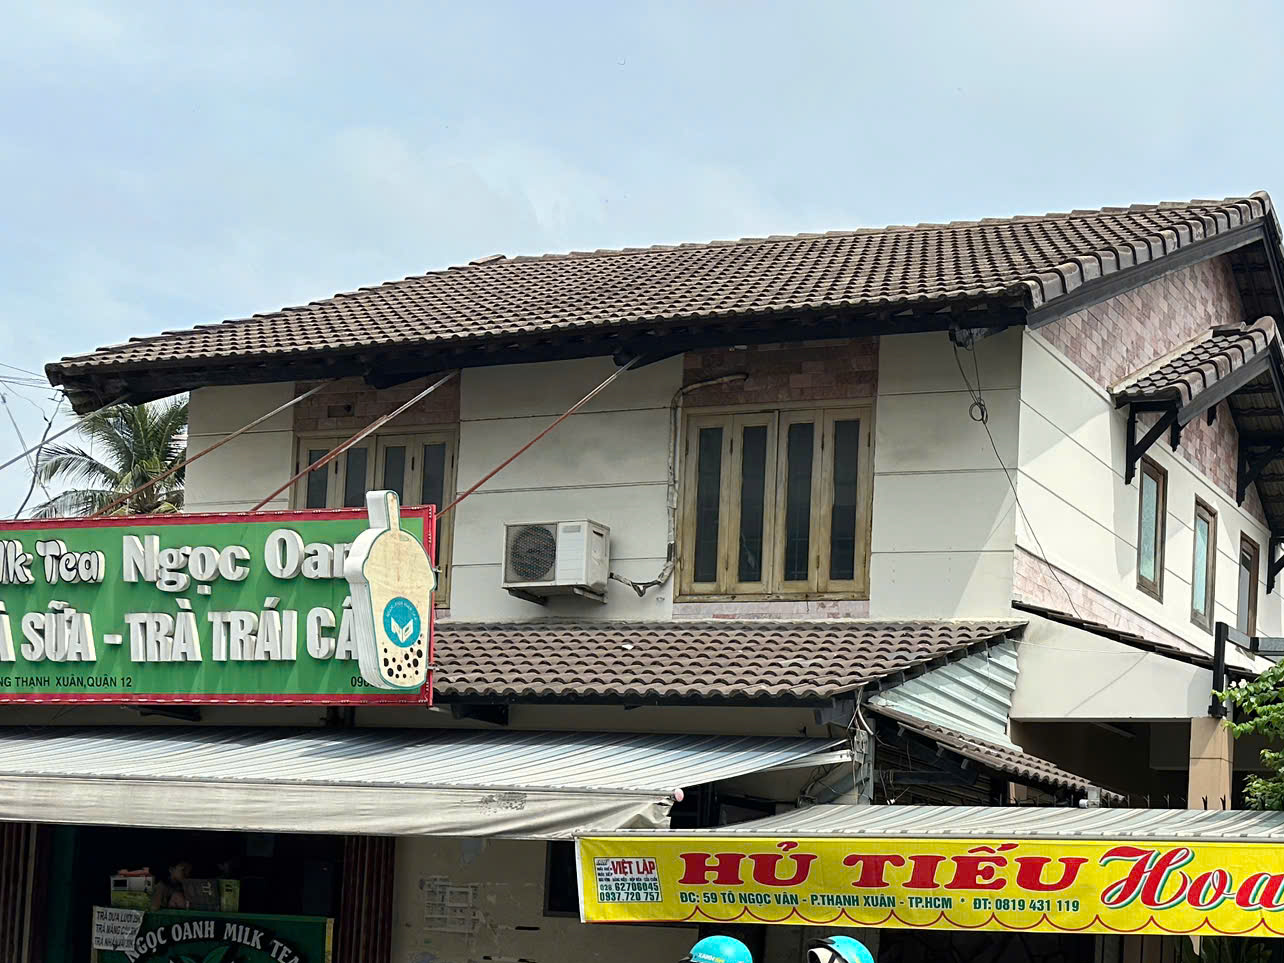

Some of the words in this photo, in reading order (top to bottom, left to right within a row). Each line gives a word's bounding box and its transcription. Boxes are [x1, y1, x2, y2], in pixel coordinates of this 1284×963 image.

[35, 539, 105, 585] Tea
[123, 535, 250, 596] Ngọc
[21, 600, 97, 662] SỮA
[124, 598, 203, 663] TRÀ
[207, 595, 298, 662] TRÁI
[15, 676, 50, 690] THẠNH
[120, 677, 132, 688] 12
[611, 859, 633, 876] VIỆT
[677, 841, 818, 888] HỦ
[842, 842, 1090, 893] TIẾU
[643, 892, 660, 902] 757
[680, 891, 700, 903] ĐC:
[703, 892, 718, 904] 59
[738, 892, 772, 907] NGỌC
[774, 892, 799, 905] VÂN
[810, 894, 860, 908] P.THẠNH
[863, 894, 896, 908] XUÂN
[907, 896, 953, 909] TP.HCM
[973, 898, 992, 910] ĐT:
[995, 898, 1026, 911] 0819
[1029, 899, 1051, 912] 431
[1057, 900, 1080, 912] 119
[124, 926, 167, 963] NGỌC
[171, 920, 216, 942] OANH
[223, 923, 265, 950] MILK
